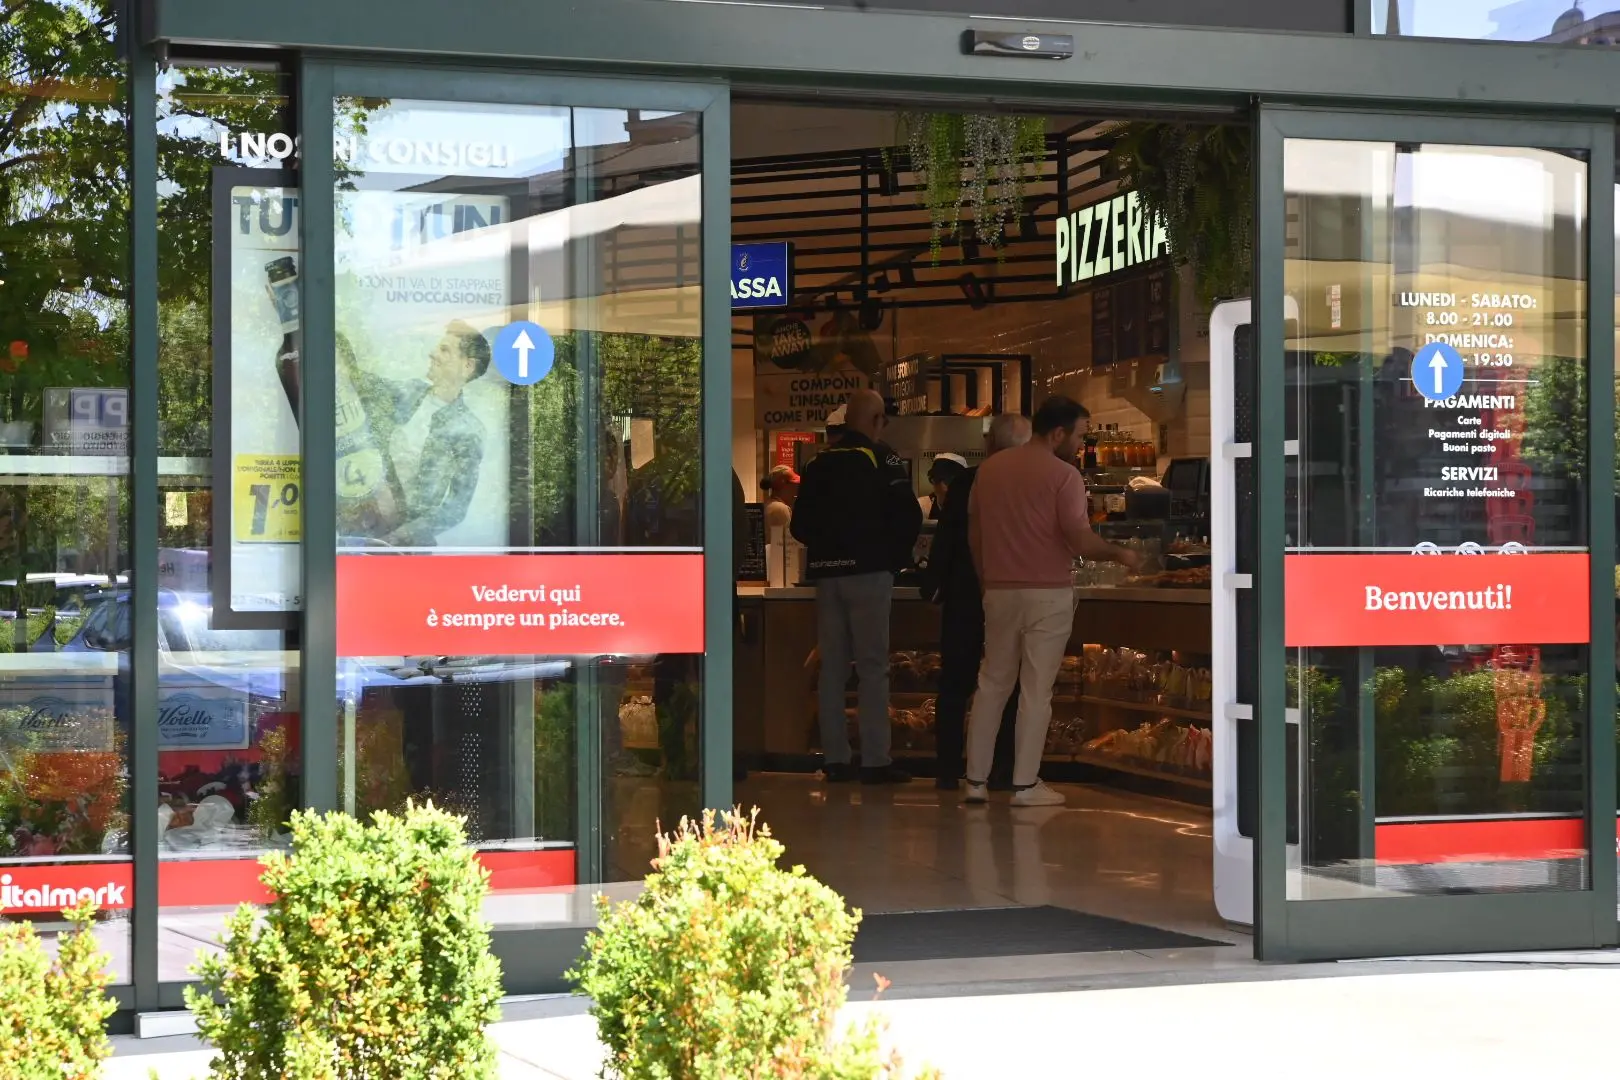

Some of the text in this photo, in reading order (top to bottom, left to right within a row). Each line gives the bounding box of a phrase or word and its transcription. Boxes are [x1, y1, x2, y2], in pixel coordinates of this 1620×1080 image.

[369, 140, 513, 168] CONSIGLI
[1056, 190, 1170, 287] PIZZERIA
[447, 278, 502, 291] STAPPARE
[386, 291, 503, 305] UN'OCCASIONE?
[1471, 293, 1537, 308] SABATO:
[1426, 312, 1458, 325] 8.00
[1471, 313, 1513, 327] 21.00
[1425, 333, 1514, 348] DOMENICA:
[1473, 353, 1513, 367] 19.30
[790, 376, 860, 392] COMPONI
[789, 392, 851, 407] L'INSALAT
[1424, 395, 1515, 409] PAGAMENTI
[764, 410, 802, 423] COME
[1457, 416, 1482, 425] Carte
[1428, 429, 1511, 442] Pagamenti digitali
[1442, 443, 1496, 455] Buoni pasto
[1441, 466, 1498, 481] SERVIZI
[1423, 488, 1516, 498] Ricariche telefoniche
[470, 585, 581, 606] Vedervi qui
[1364, 584, 1513, 611] Benvenuti!
[426, 608, 625, 631] è sempre un piacere.
[157, 703, 213, 727] Voiello
[0, 873, 126, 908] italmark
